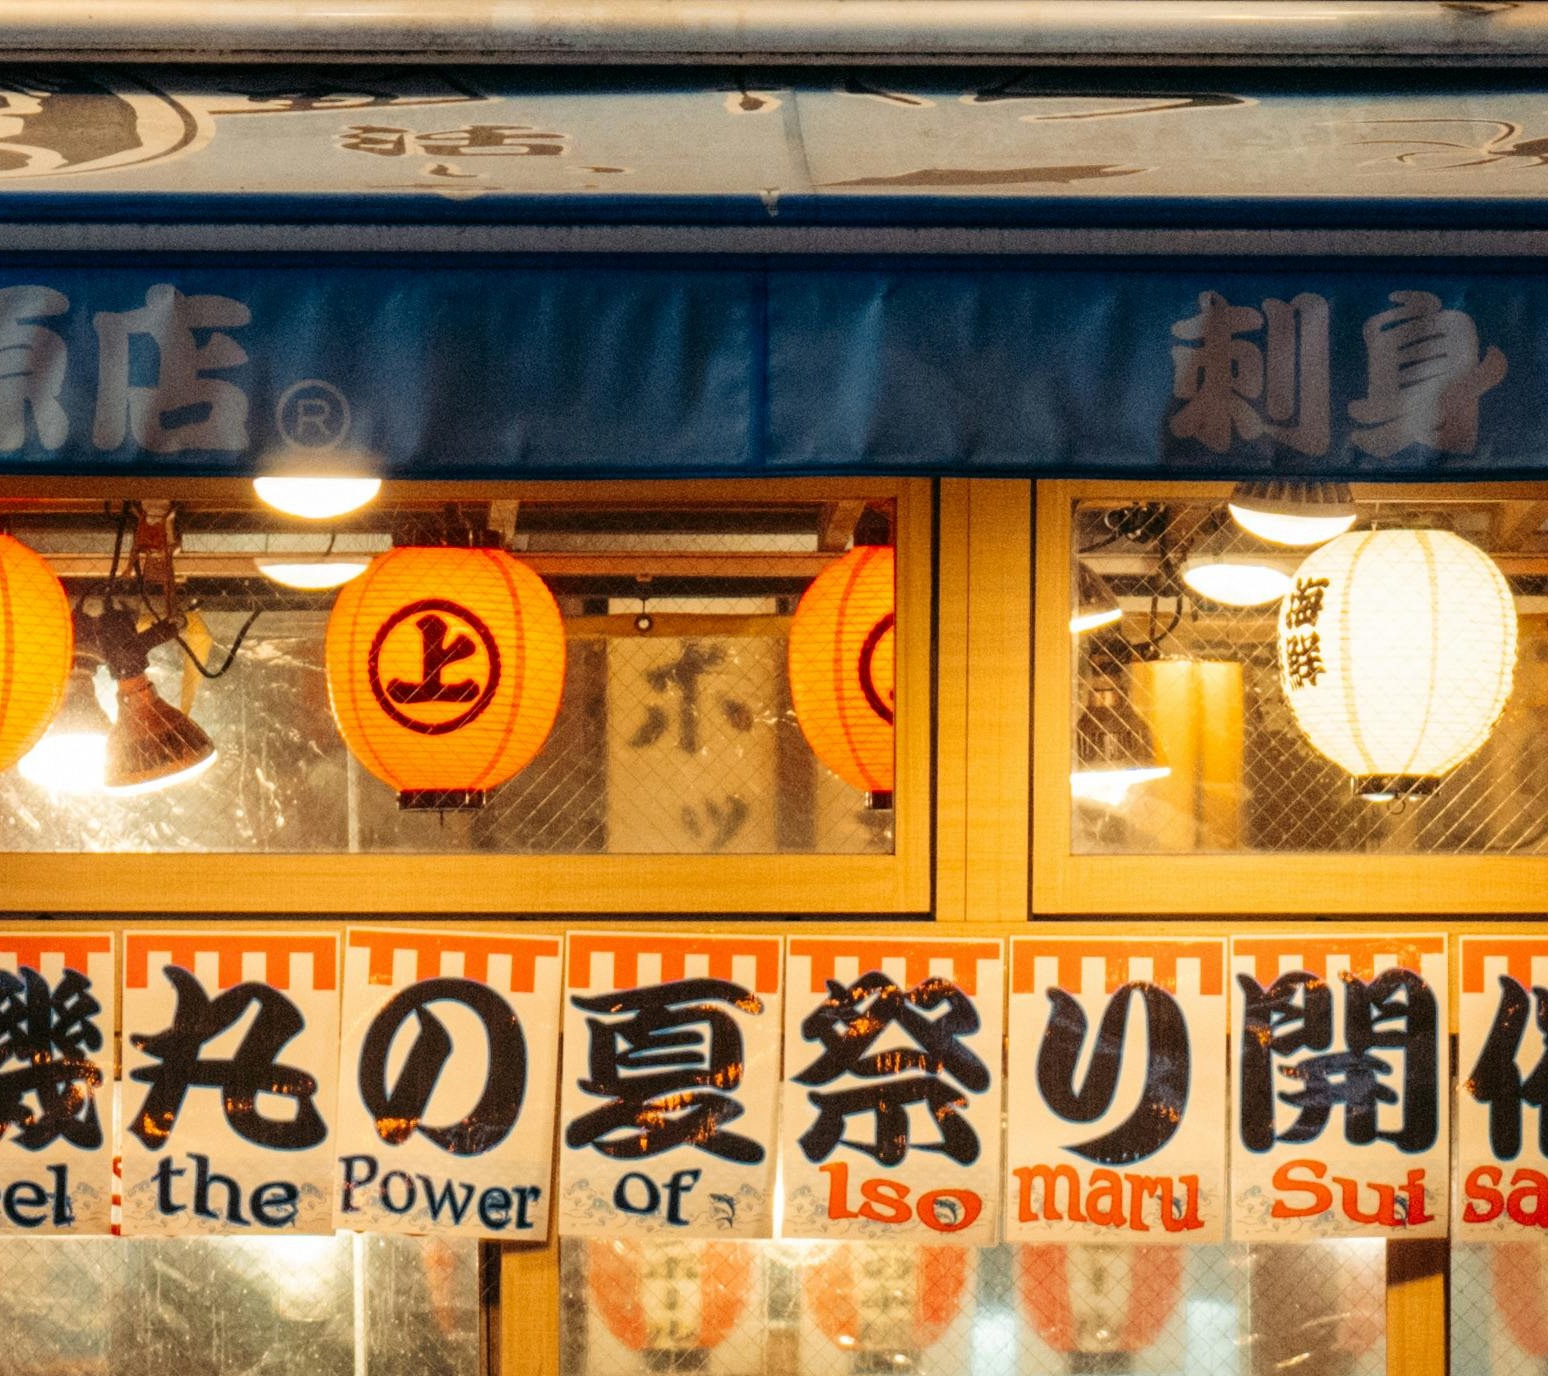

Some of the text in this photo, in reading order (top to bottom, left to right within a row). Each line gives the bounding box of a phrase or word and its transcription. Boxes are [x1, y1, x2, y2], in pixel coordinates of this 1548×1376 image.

[1169, 290, 1507, 456] 刺身
[386, 614, 482, 707] 上
[157, 1154, 300, 1226] the
[339, 1156, 541, 1231] Power
[614, 1167, 701, 1228] of
[1017, 1164, 1205, 1234] maru
[1273, 1157, 1437, 1227] Sui
